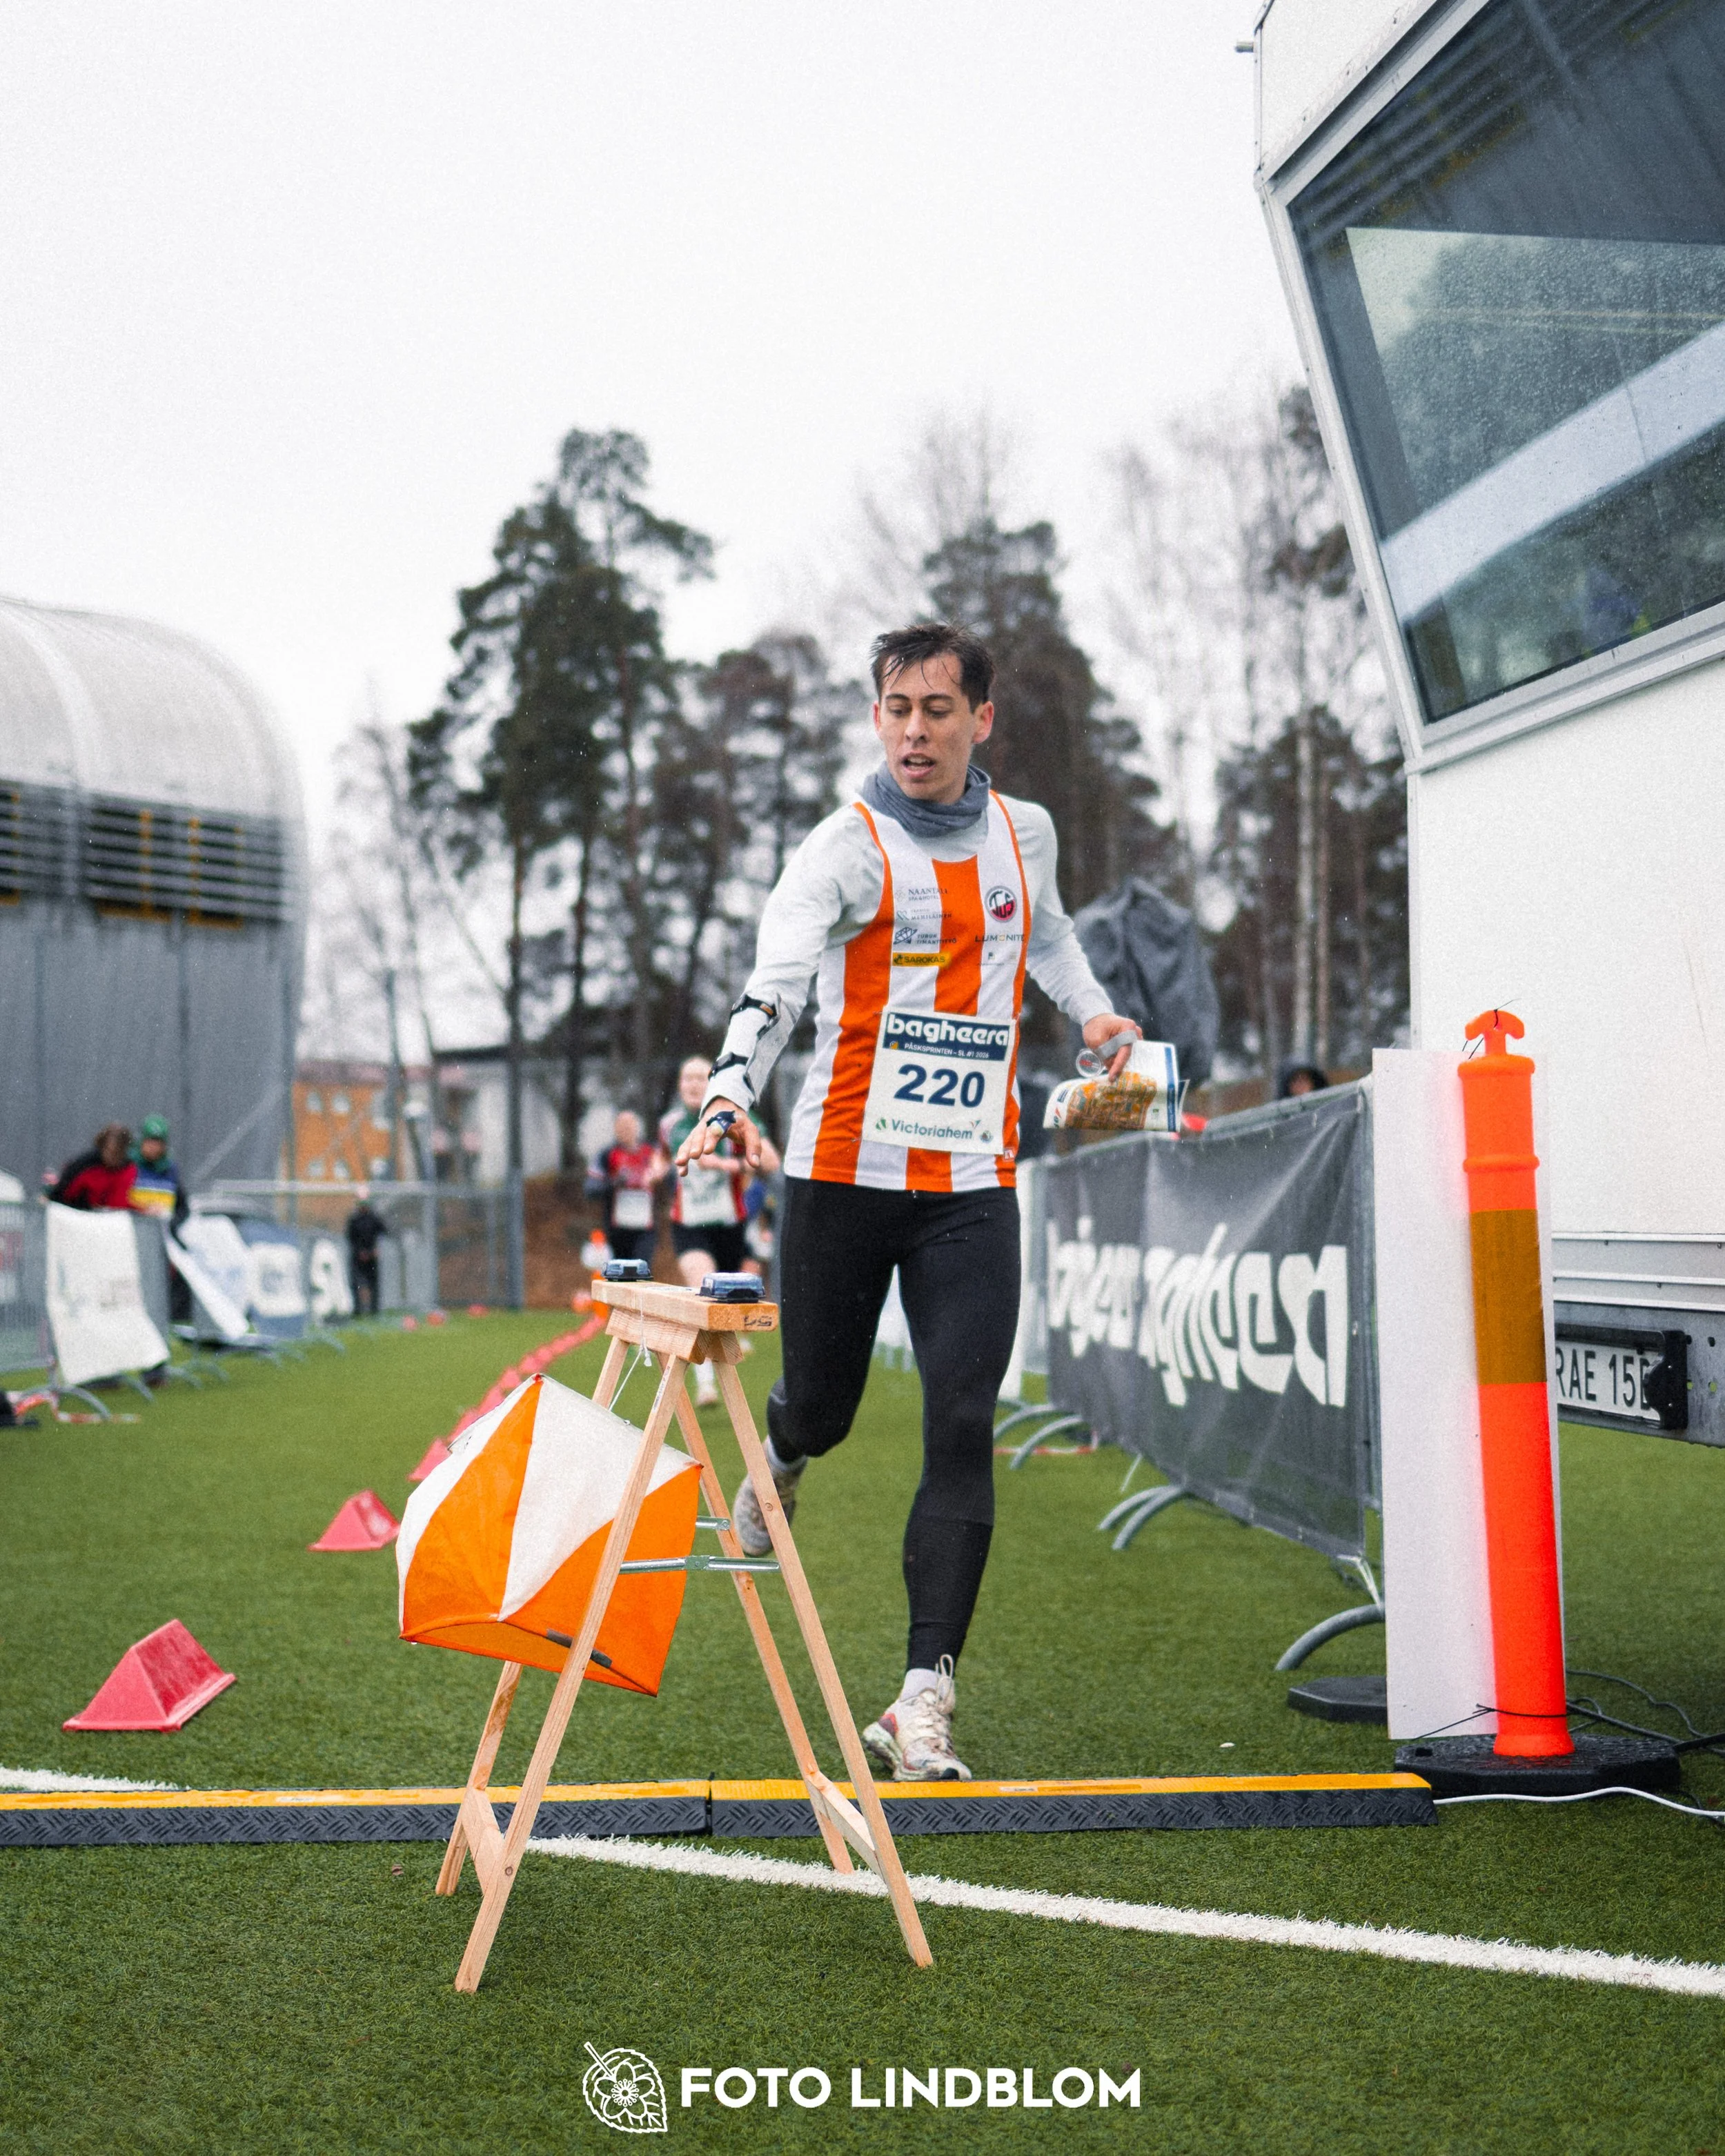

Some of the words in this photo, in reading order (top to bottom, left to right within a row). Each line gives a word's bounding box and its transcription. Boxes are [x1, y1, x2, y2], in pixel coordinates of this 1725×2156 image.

[887, 1014, 1009, 1047] bagheera
[905, 1042, 953, 1055] PÅSKSPRINTEN
[893, 1063, 985, 1108] 220
[891, 1118, 973, 1139] Victoriahem
[1555, 1346, 1597, 1401] RAE
